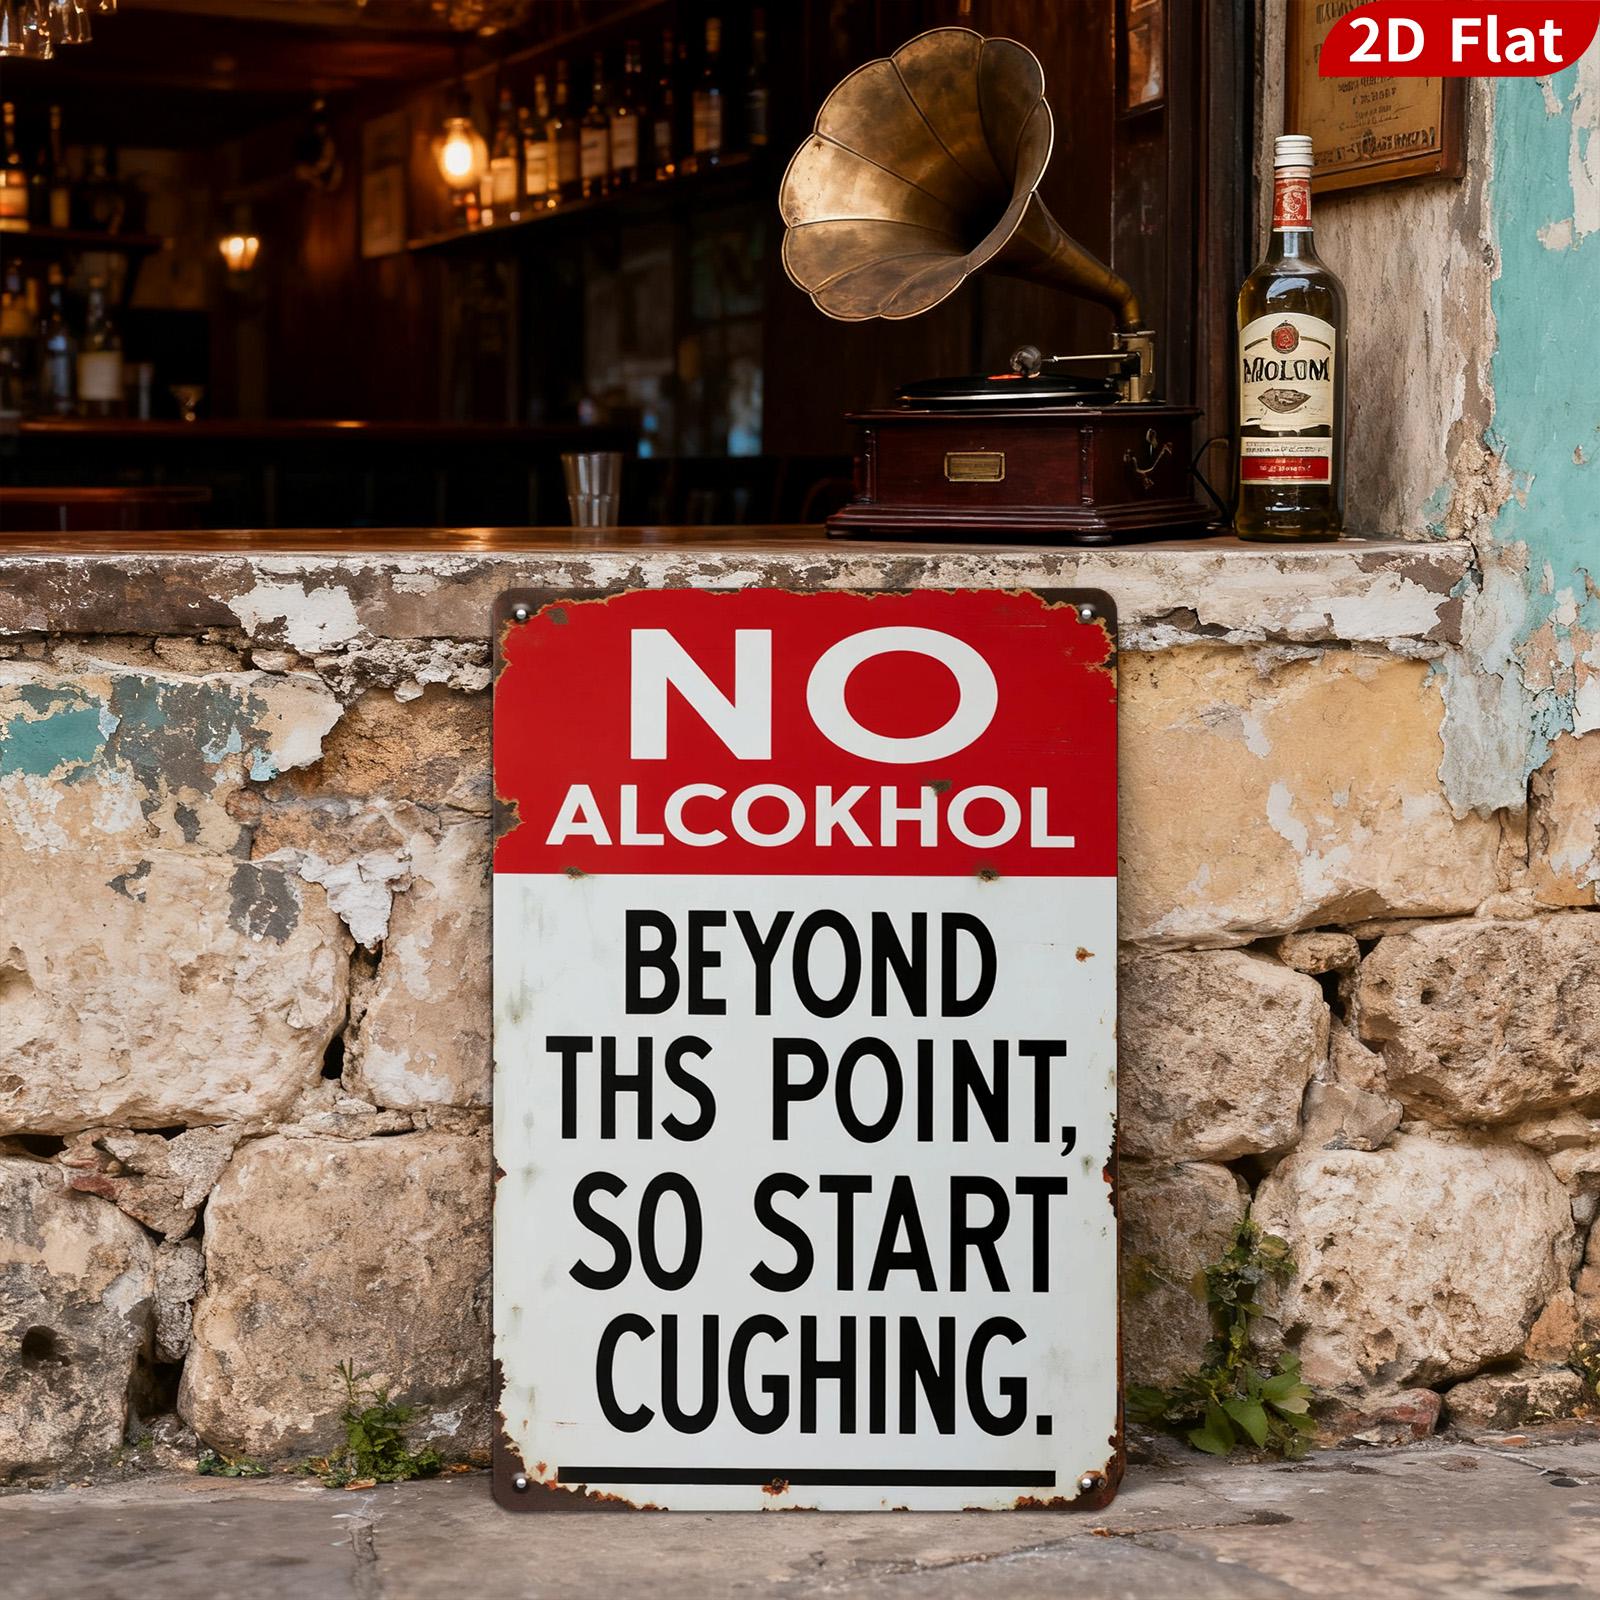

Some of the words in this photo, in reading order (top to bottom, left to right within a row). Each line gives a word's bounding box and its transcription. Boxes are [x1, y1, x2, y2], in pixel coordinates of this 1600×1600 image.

[630, 627, 998, 763] NO
[546, 784, 1075, 848] ALCOKHOL
[626, 910, 997, 1018] BEYOND
[546, 1036, 716, 1141] THS
[773, 1037, 1076, 1157] POINT,
[569, 1172, 702, 1291] SO
[750, 1173, 1067, 1292] START
[596, 1313, 1053, 1436] CUGHING.
